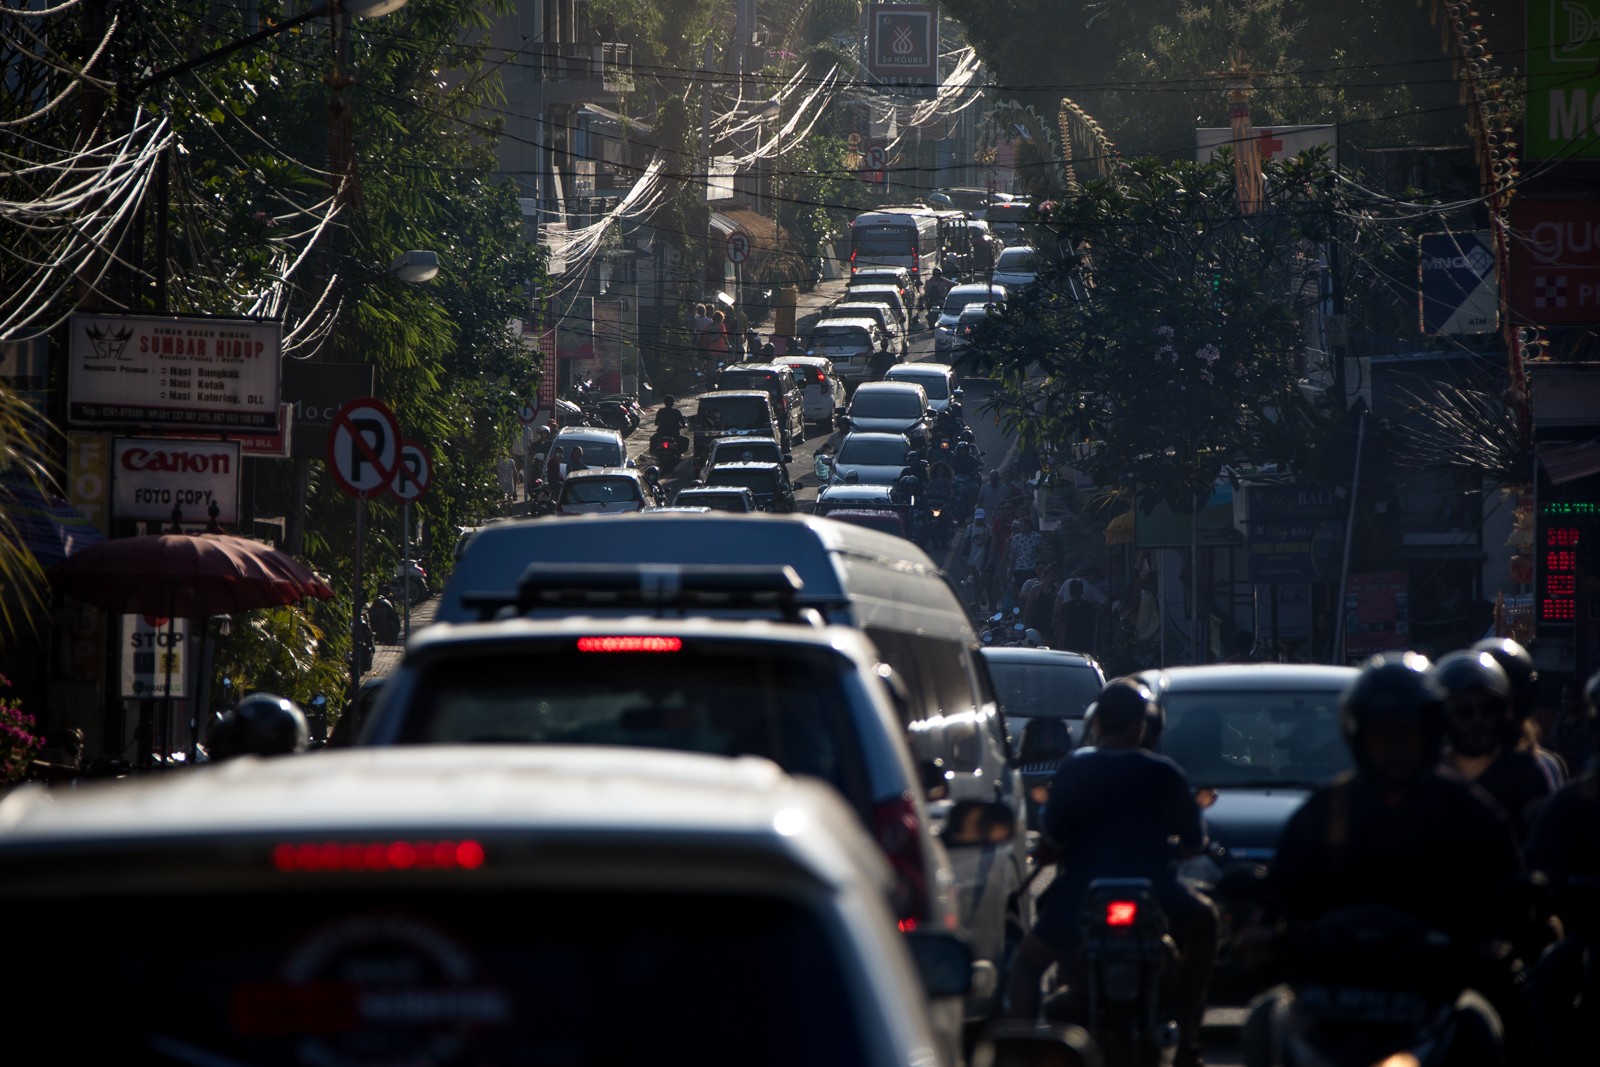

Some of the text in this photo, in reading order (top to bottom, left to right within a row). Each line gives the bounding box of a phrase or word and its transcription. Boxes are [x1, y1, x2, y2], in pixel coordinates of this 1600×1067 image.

[894, 56, 923, 64] HOURS
[1549, 88, 1600, 140] M
[1531, 221, 1600, 263] gu
[1468, 317, 1488, 326] ATM
[140, 335, 264, 359] SUMBAR HIDUP
[170, 366, 240, 379] Nasi Bungkus
[169, 379, 225, 390] Nasi Kotak
[169, 391, 191, 400] Nasi
[247, 394, 265, 404] DLL
[256, 439, 273, 447] DLL
[121, 447, 230, 474] Canon
[135, 488, 213, 505] FOTO COPY
[1291, 528, 1312, 537] BALI
[131, 632, 184, 648] STOP
